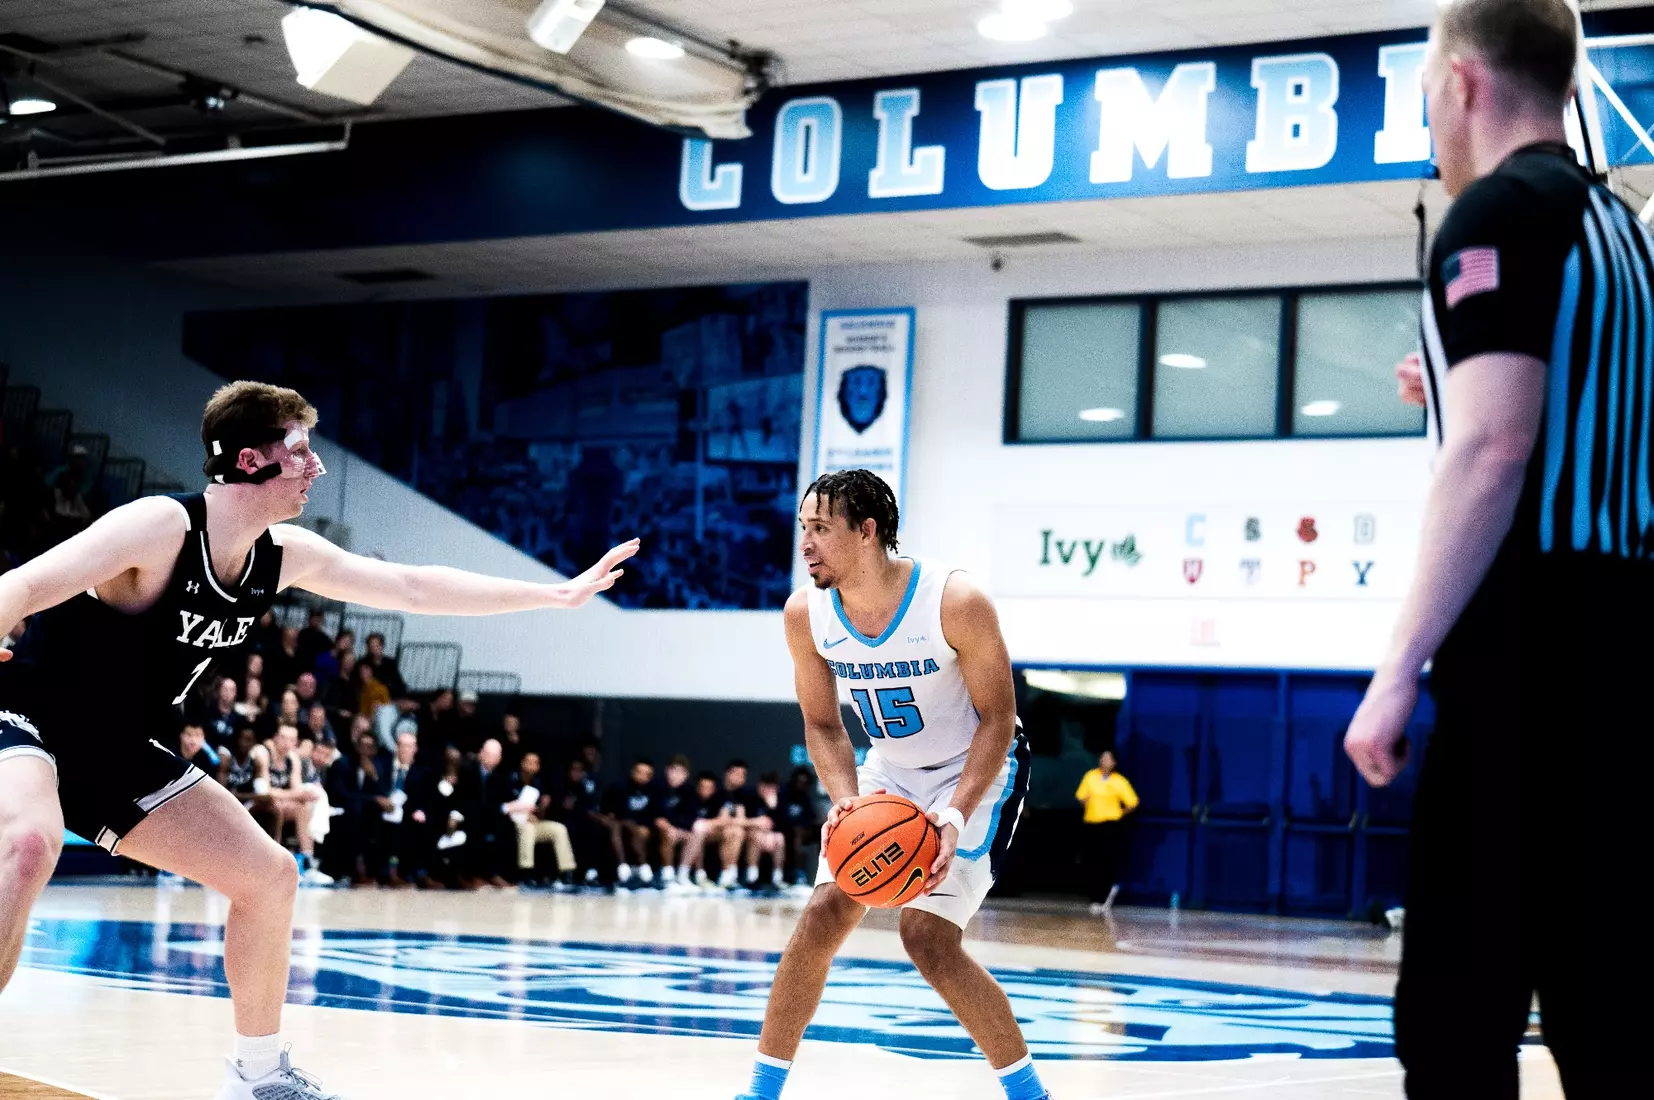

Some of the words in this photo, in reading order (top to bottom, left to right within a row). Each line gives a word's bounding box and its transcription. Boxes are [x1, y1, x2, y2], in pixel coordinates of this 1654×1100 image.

[679, 42, 1587, 212] COLUMBI
[1040, 529, 1105, 577] Ivy
[1299, 559, 1316, 586] P
[1351, 559, 1375, 586] Y
[176, 610, 256, 649] YALE
[906, 635, 920, 645] Ivy
[171, 657, 213, 705] 1
[849, 686, 925, 739] 15
[850, 841, 905, 888] ELITE
